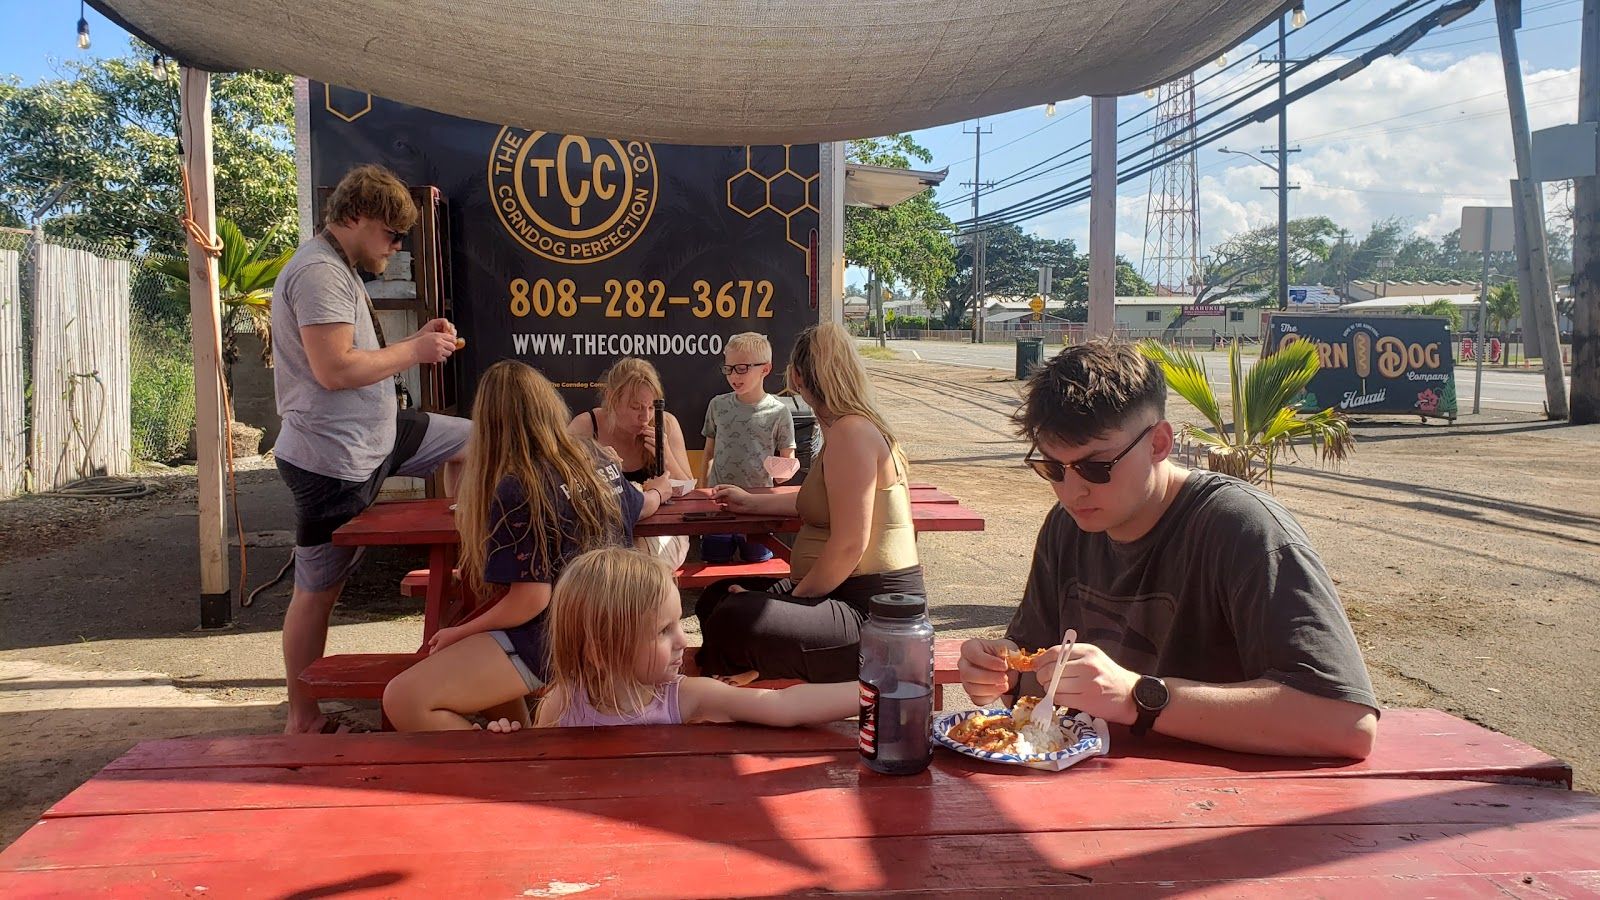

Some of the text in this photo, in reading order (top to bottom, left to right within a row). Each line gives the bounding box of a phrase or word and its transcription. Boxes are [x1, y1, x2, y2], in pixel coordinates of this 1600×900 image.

[495, 131, 649, 178] THE CO.
[530, 134, 616, 207] TCC
[498, 185, 649, 257] CORNDOG PERFECTION
[509, 278, 774, 318] 808-282-3672
[1281, 323, 1298, 333] The
[512, 334, 768, 355] WWW.THECORNDOGCO.
[1278, 333, 1441, 378] RN DOG
[1462, 337, 1502, 361] RD
[1407, 371, 1449, 384] Company
[1341, 388, 1386, 409] Hawaii
